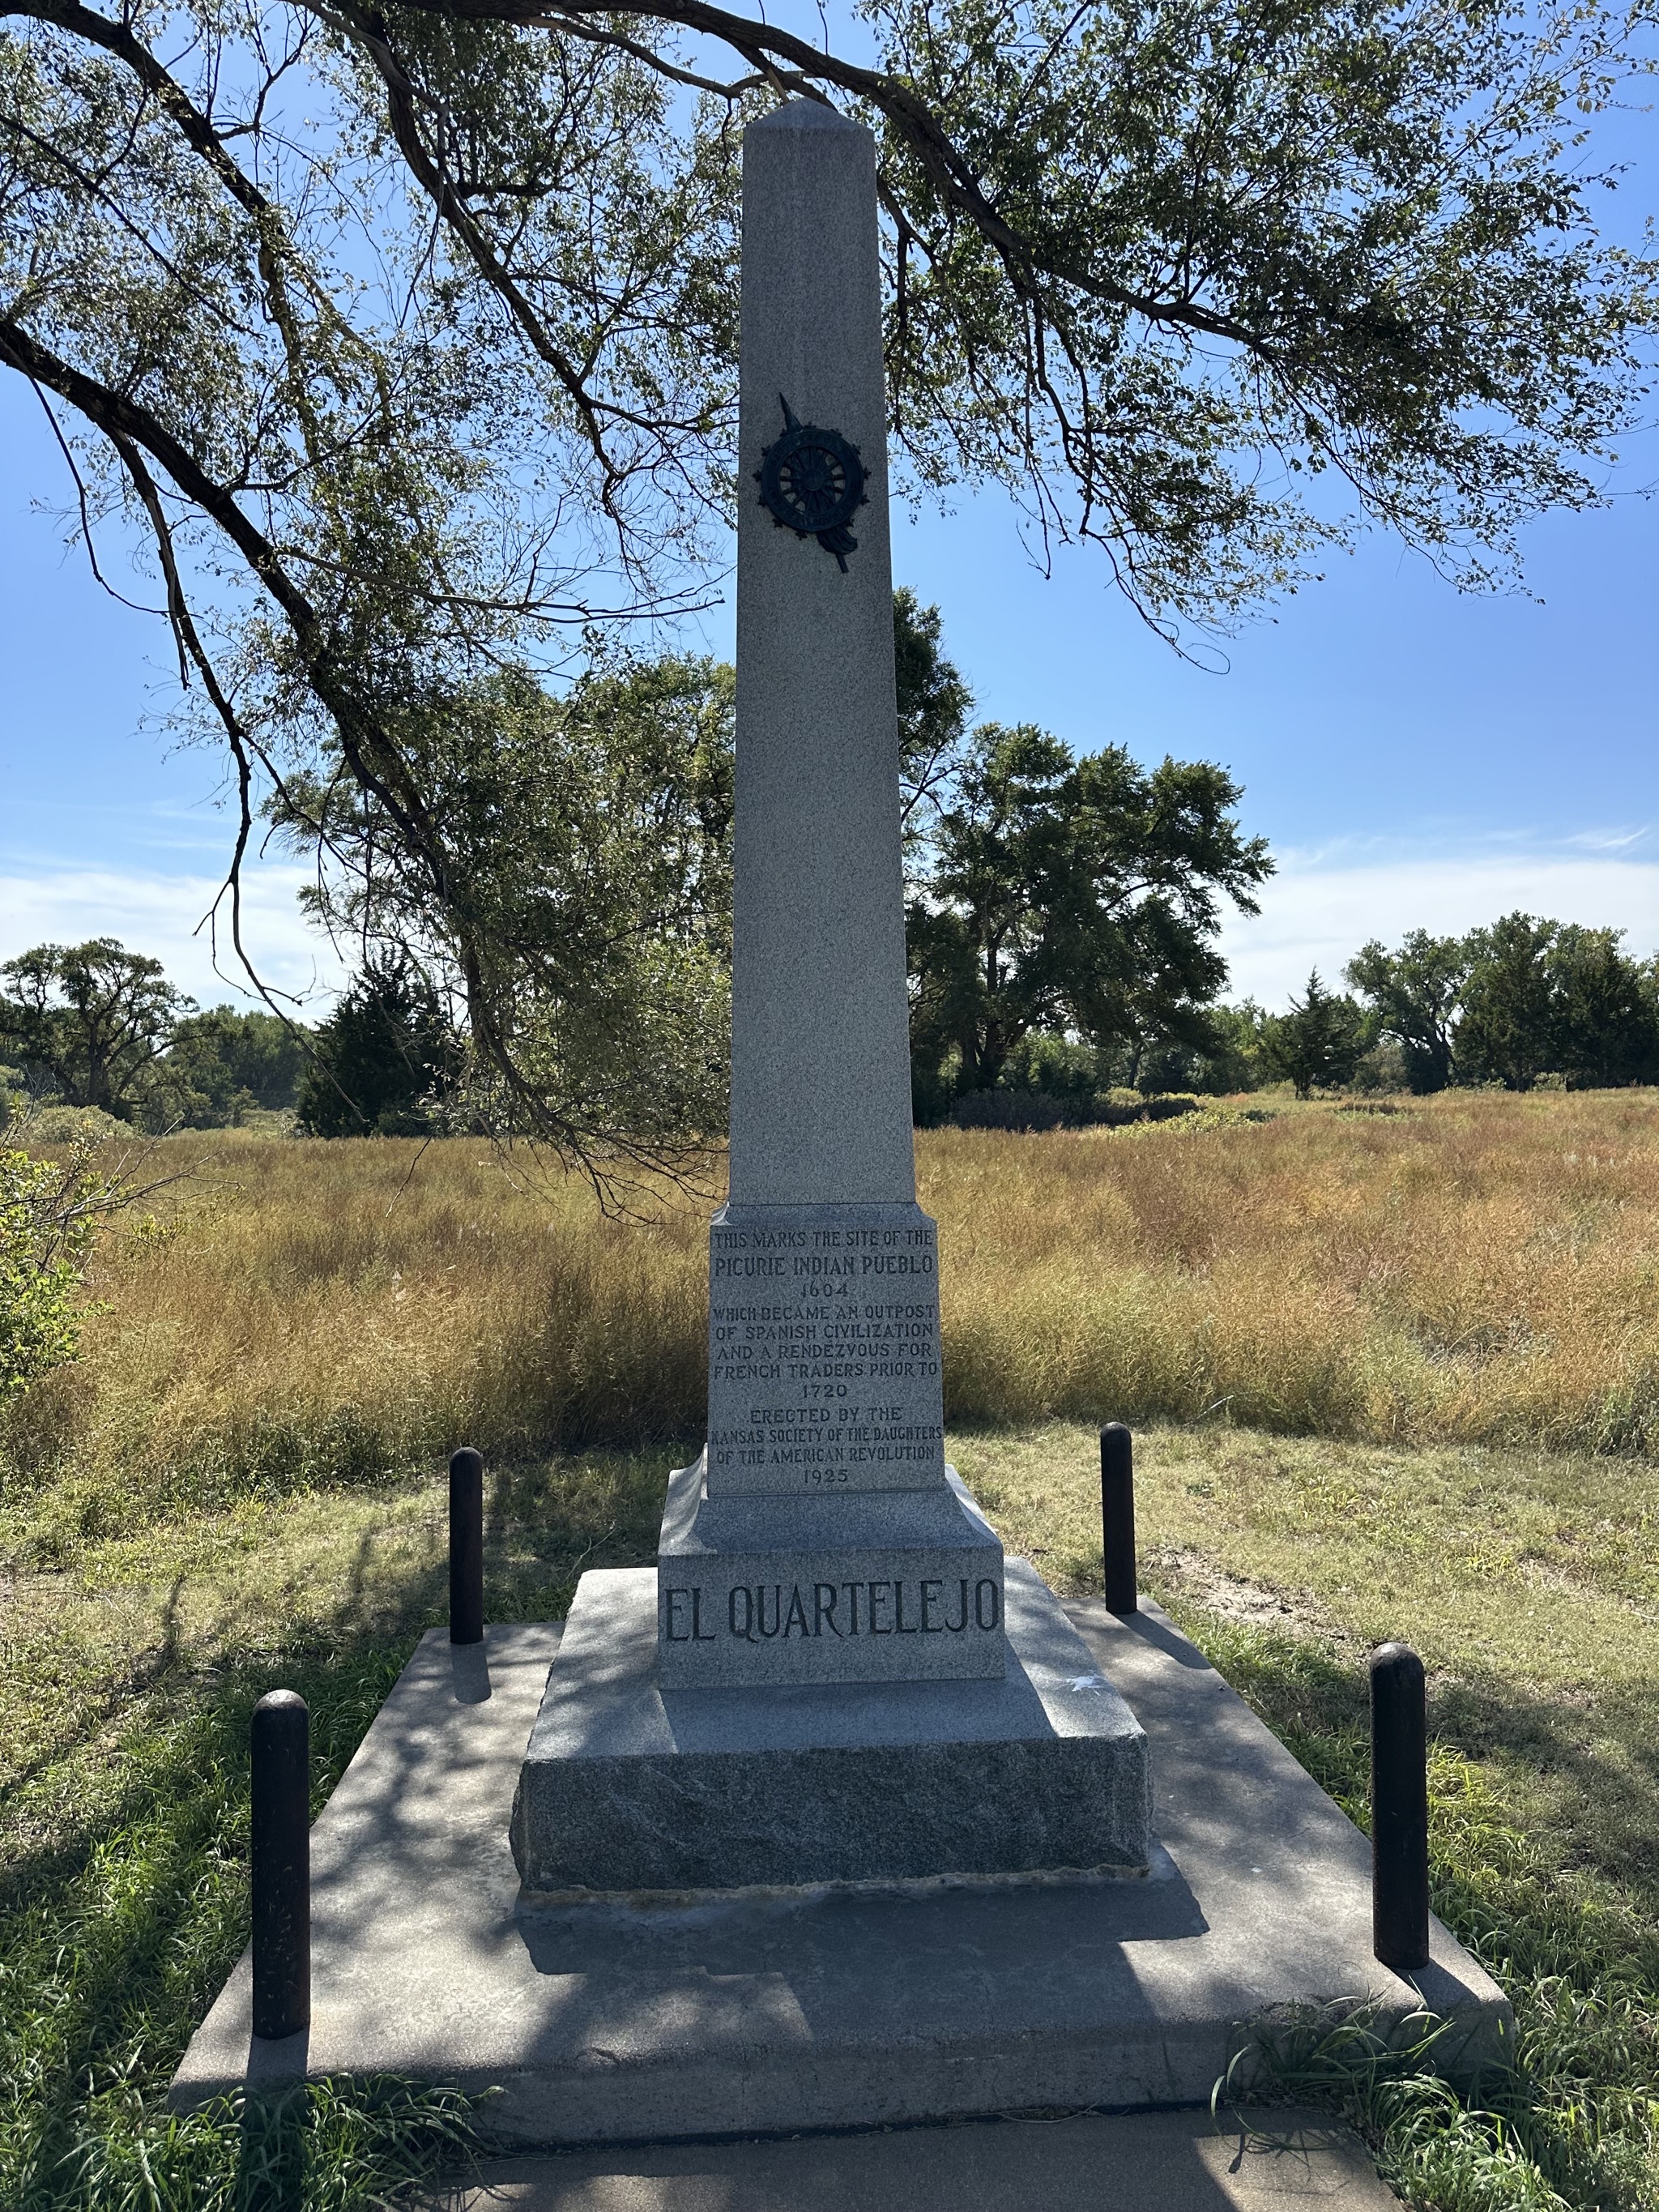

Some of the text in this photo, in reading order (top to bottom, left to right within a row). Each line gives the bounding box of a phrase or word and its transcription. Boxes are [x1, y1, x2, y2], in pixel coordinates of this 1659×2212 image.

[714, 1229, 932, 1249] THIS MARKS THE SITE OF THE
[715, 1255, 932, 1277] PICURIE INDIAN PUEBLO
[800, 1280, 849, 1297] 1604
[713, 1305, 935, 1322] WHICH BECAME AN OUTPOST
[716, 1322, 932, 1340] OF SPANISH CIVILIZATION
[717, 1343, 932, 1360] AND A RENDEZVOUS FOR
[714, 1361, 937, 1380] FRENCH TRADERS PRIOR TO
[803, 1384, 847, 1399] 1720
[750, 1407, 903, 1424] ERECTED BY THE
[712, 1426, 942, 1445] KANSAS SOCIETY OF THE DAUGHTERS
[716, 1445, 935, 1465] OF THE AMERICAN REVOLUTION
[804, 1468, 849, 1485] 1925
[665, 1578, 999, 1643] EL QUARTELEJO
